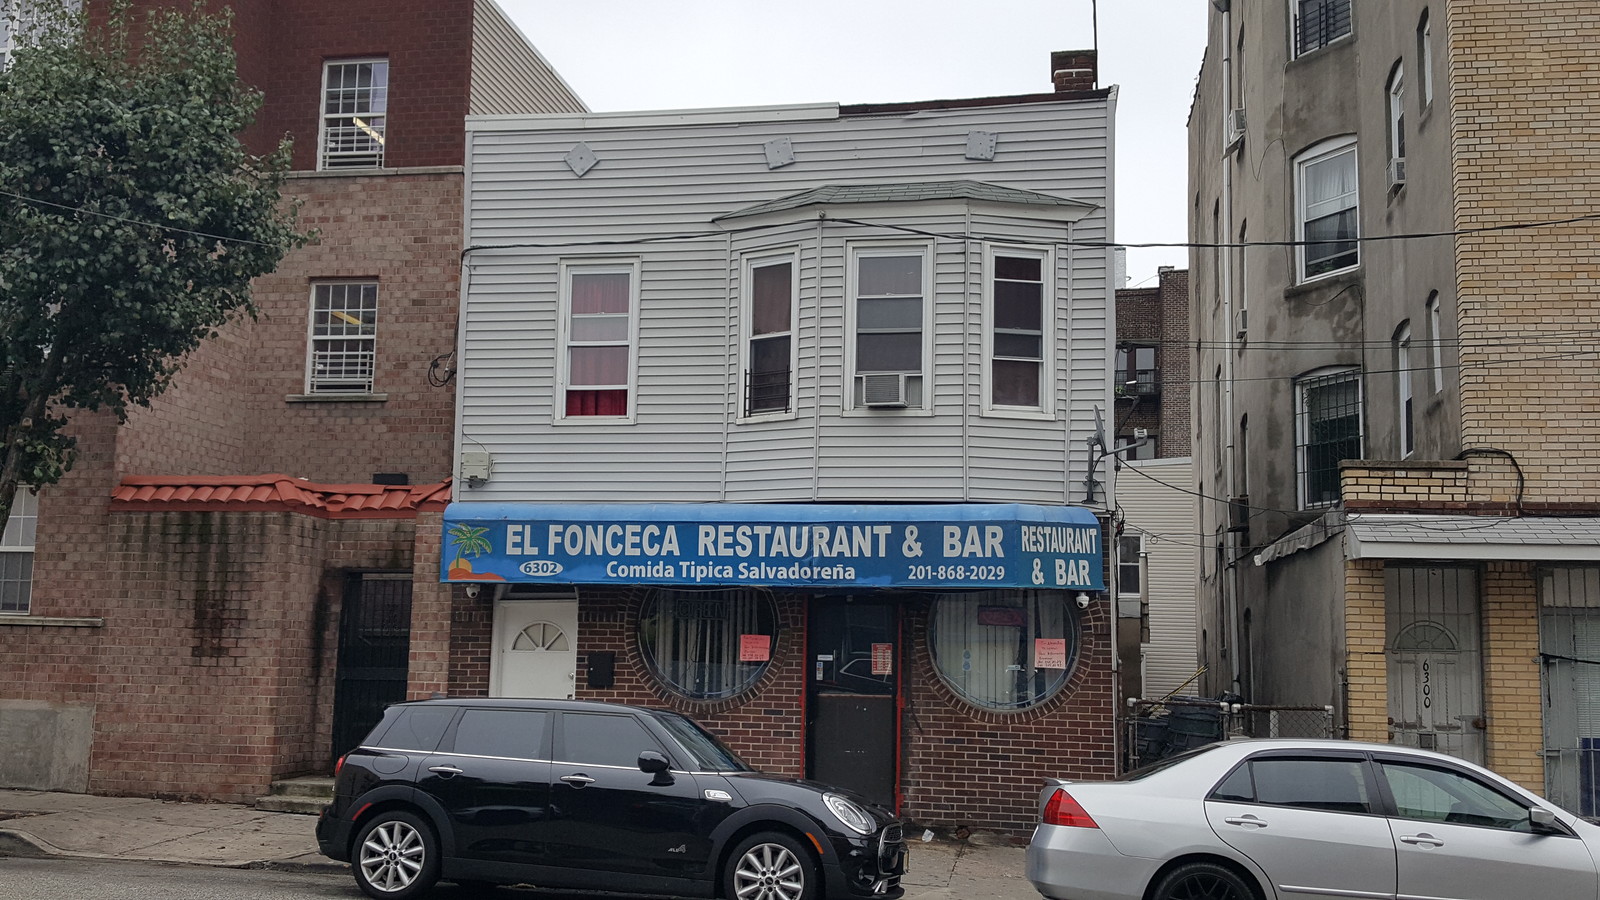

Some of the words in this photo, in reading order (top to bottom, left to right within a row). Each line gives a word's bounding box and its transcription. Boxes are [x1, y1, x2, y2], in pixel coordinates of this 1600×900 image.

[505, 524, 539, 556] EL
[548, 524, 681, 557] FONCECA
[698, 525, 892, 558] RESTAURANT
[902, 525, 923, 558] &
[943, 525, 1005, 558] BAR
[1021, 525, 1098, 555] RESTAURANT
[524, 562, 559, 574] 6302
[606, 561, 675, 579] Comida
[679, 561, 733, 582] Tipica
[738, 562, 856, 580] Salvadoreña
[907, 565, 1006, 581] 201-868-2029
[1031, 557, 1045, 586] &
[1055, 558, 1091, 587] BAR
[1422, 659, 1431, 709] 6300
